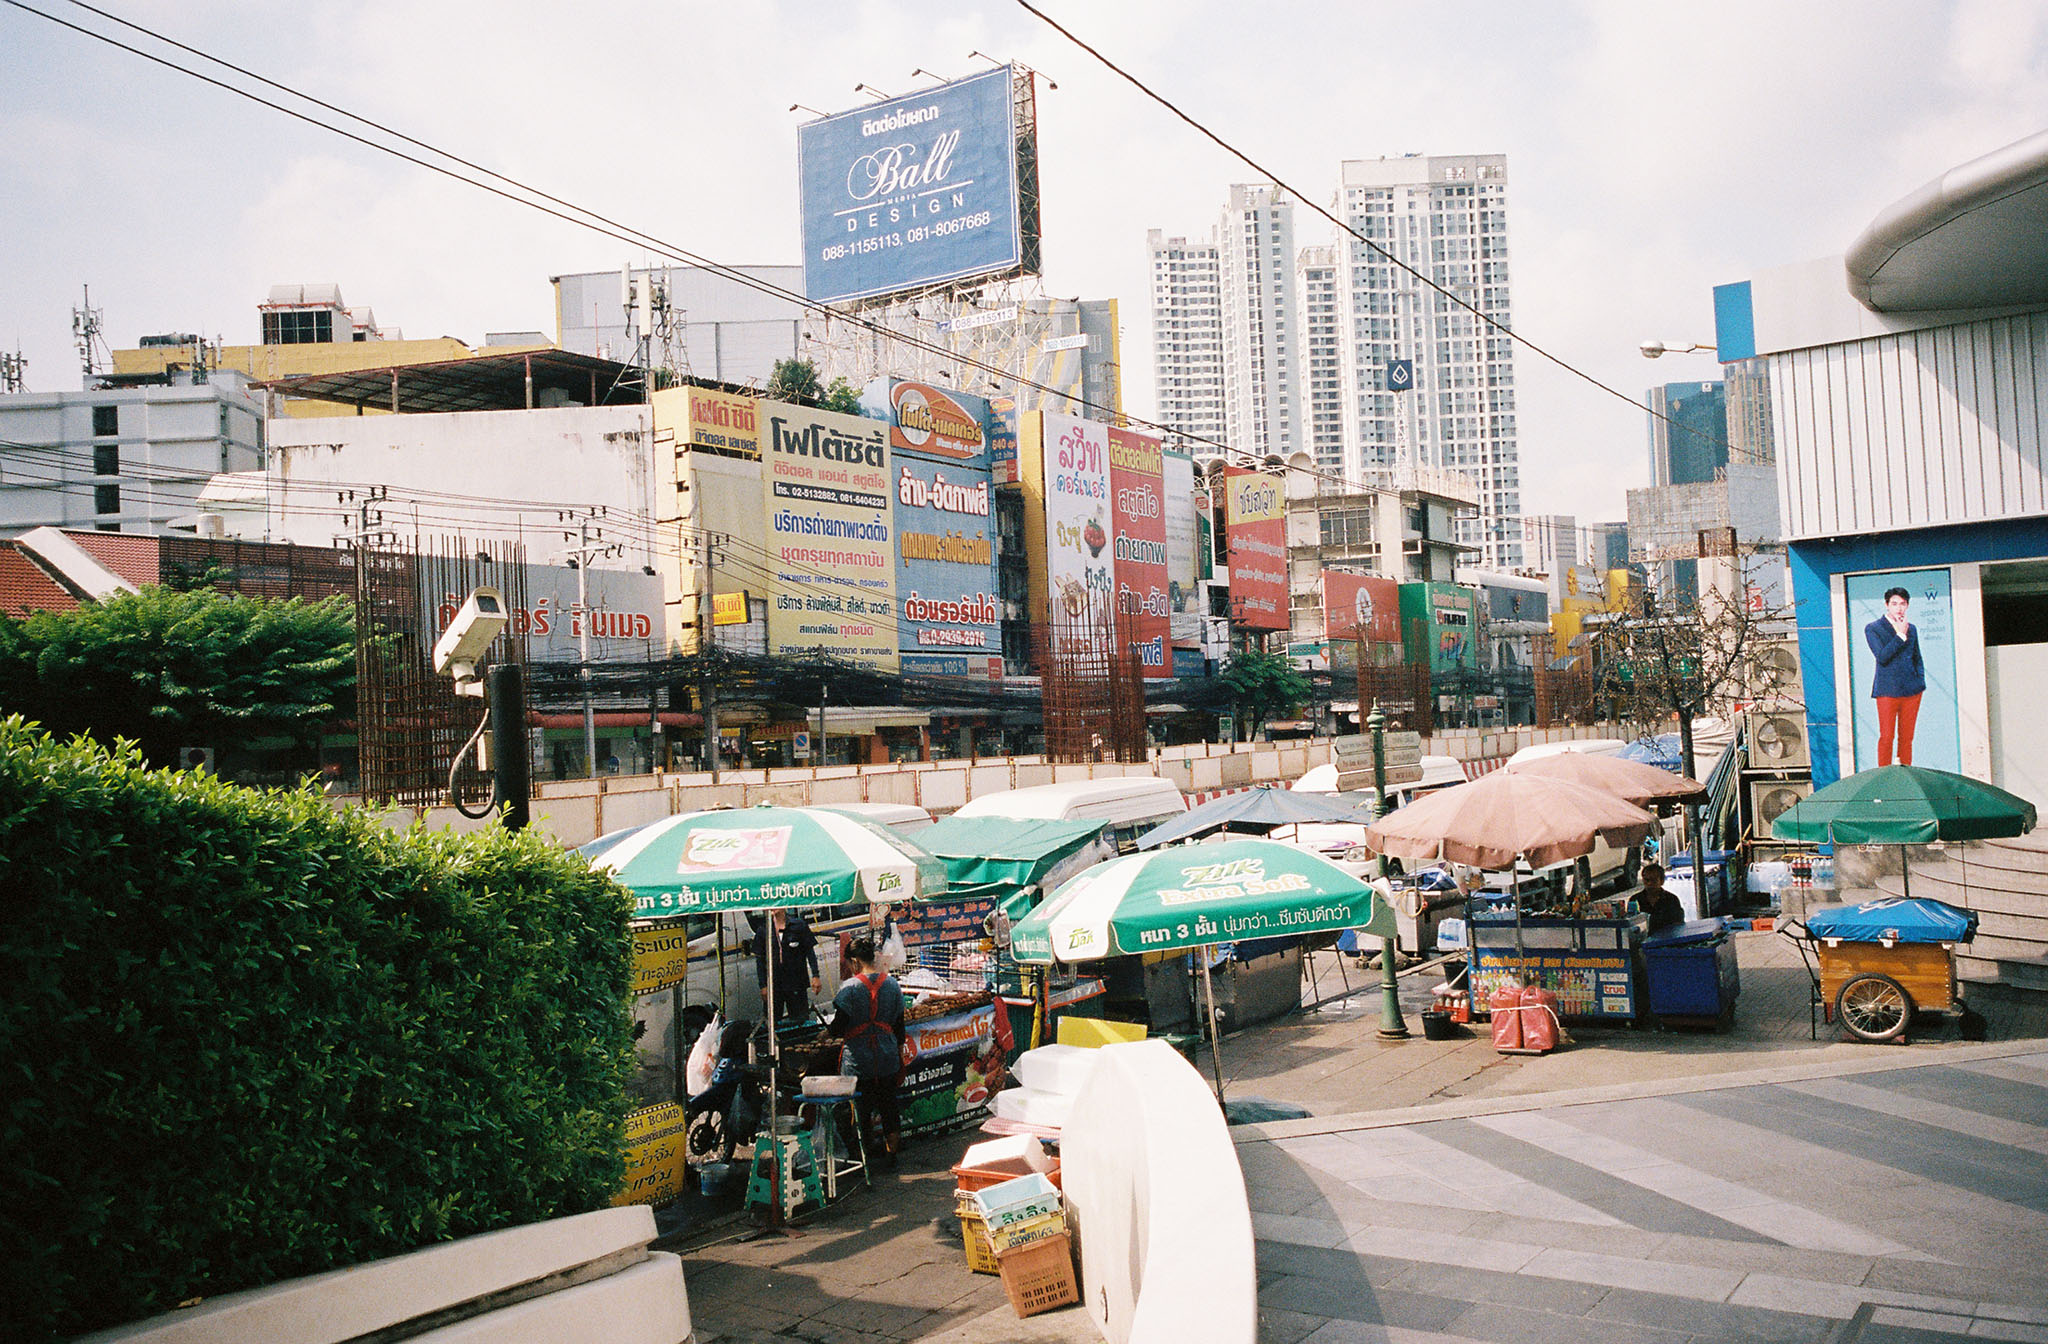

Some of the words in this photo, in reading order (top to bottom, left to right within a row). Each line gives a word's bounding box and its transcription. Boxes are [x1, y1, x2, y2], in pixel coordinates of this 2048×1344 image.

[862, 104, 939, 137] ติดต่อโฆษณา
[847, 129, 960, 200] Ball
[847, 192, 964, 232] DESIGN
[907, 211, 990, 243] 081-8067668
[1059, 426, 1103, 475] สวีท
[1057, 471, 1105, 499] คอร์เนอร์
[1118, 483, 1160, 522] สตูดิโอ
[774, 509, 888, 542] บริการถ่ายภาพเวดดิ้ง
[781, 546, 884, 568] ชุดครุยทุกสถาบัน
[1116, 529, 1166, 565] ถ่ายภาพ
[905, 590, 997, 625] ด่วนรอรับได้
[661, 893, 673, 908] 3
[678, 886, 701, 906] ชั้น
[1159, 887, 1245, 905] Extra
[1244, 874, 1310, 894] Soft
[1140, 928, 1171, 944] หนา
[1177, 924, 1189, 939] 3
[1194, 915, 1218, 936] ชั้น
[1604, 985, 1625, 994] true
[647, 1108, 681, 1126] BOMB
